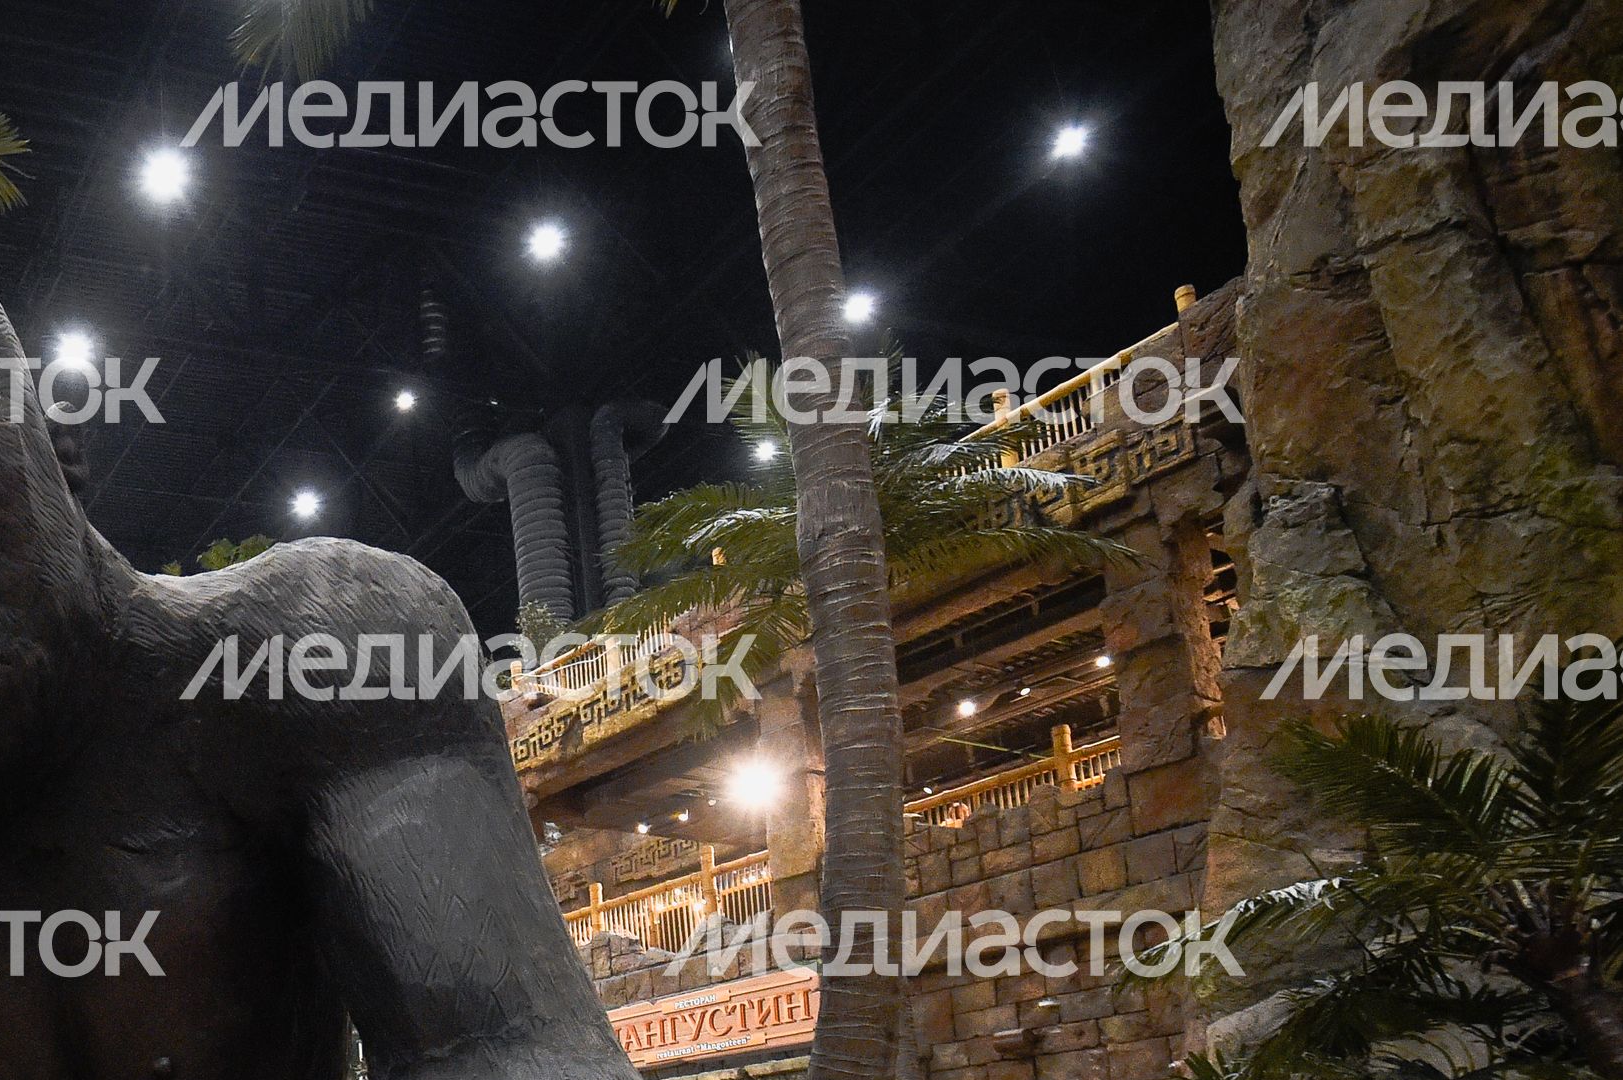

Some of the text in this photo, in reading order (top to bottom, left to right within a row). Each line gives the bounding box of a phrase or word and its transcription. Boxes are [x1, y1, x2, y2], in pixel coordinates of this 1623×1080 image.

[674, 994, 717, 1010] РЕСТОРАН
[614, 988, 814, 1054] АНГУСТИН
[656, 1044, 695, 1060] restaurant
